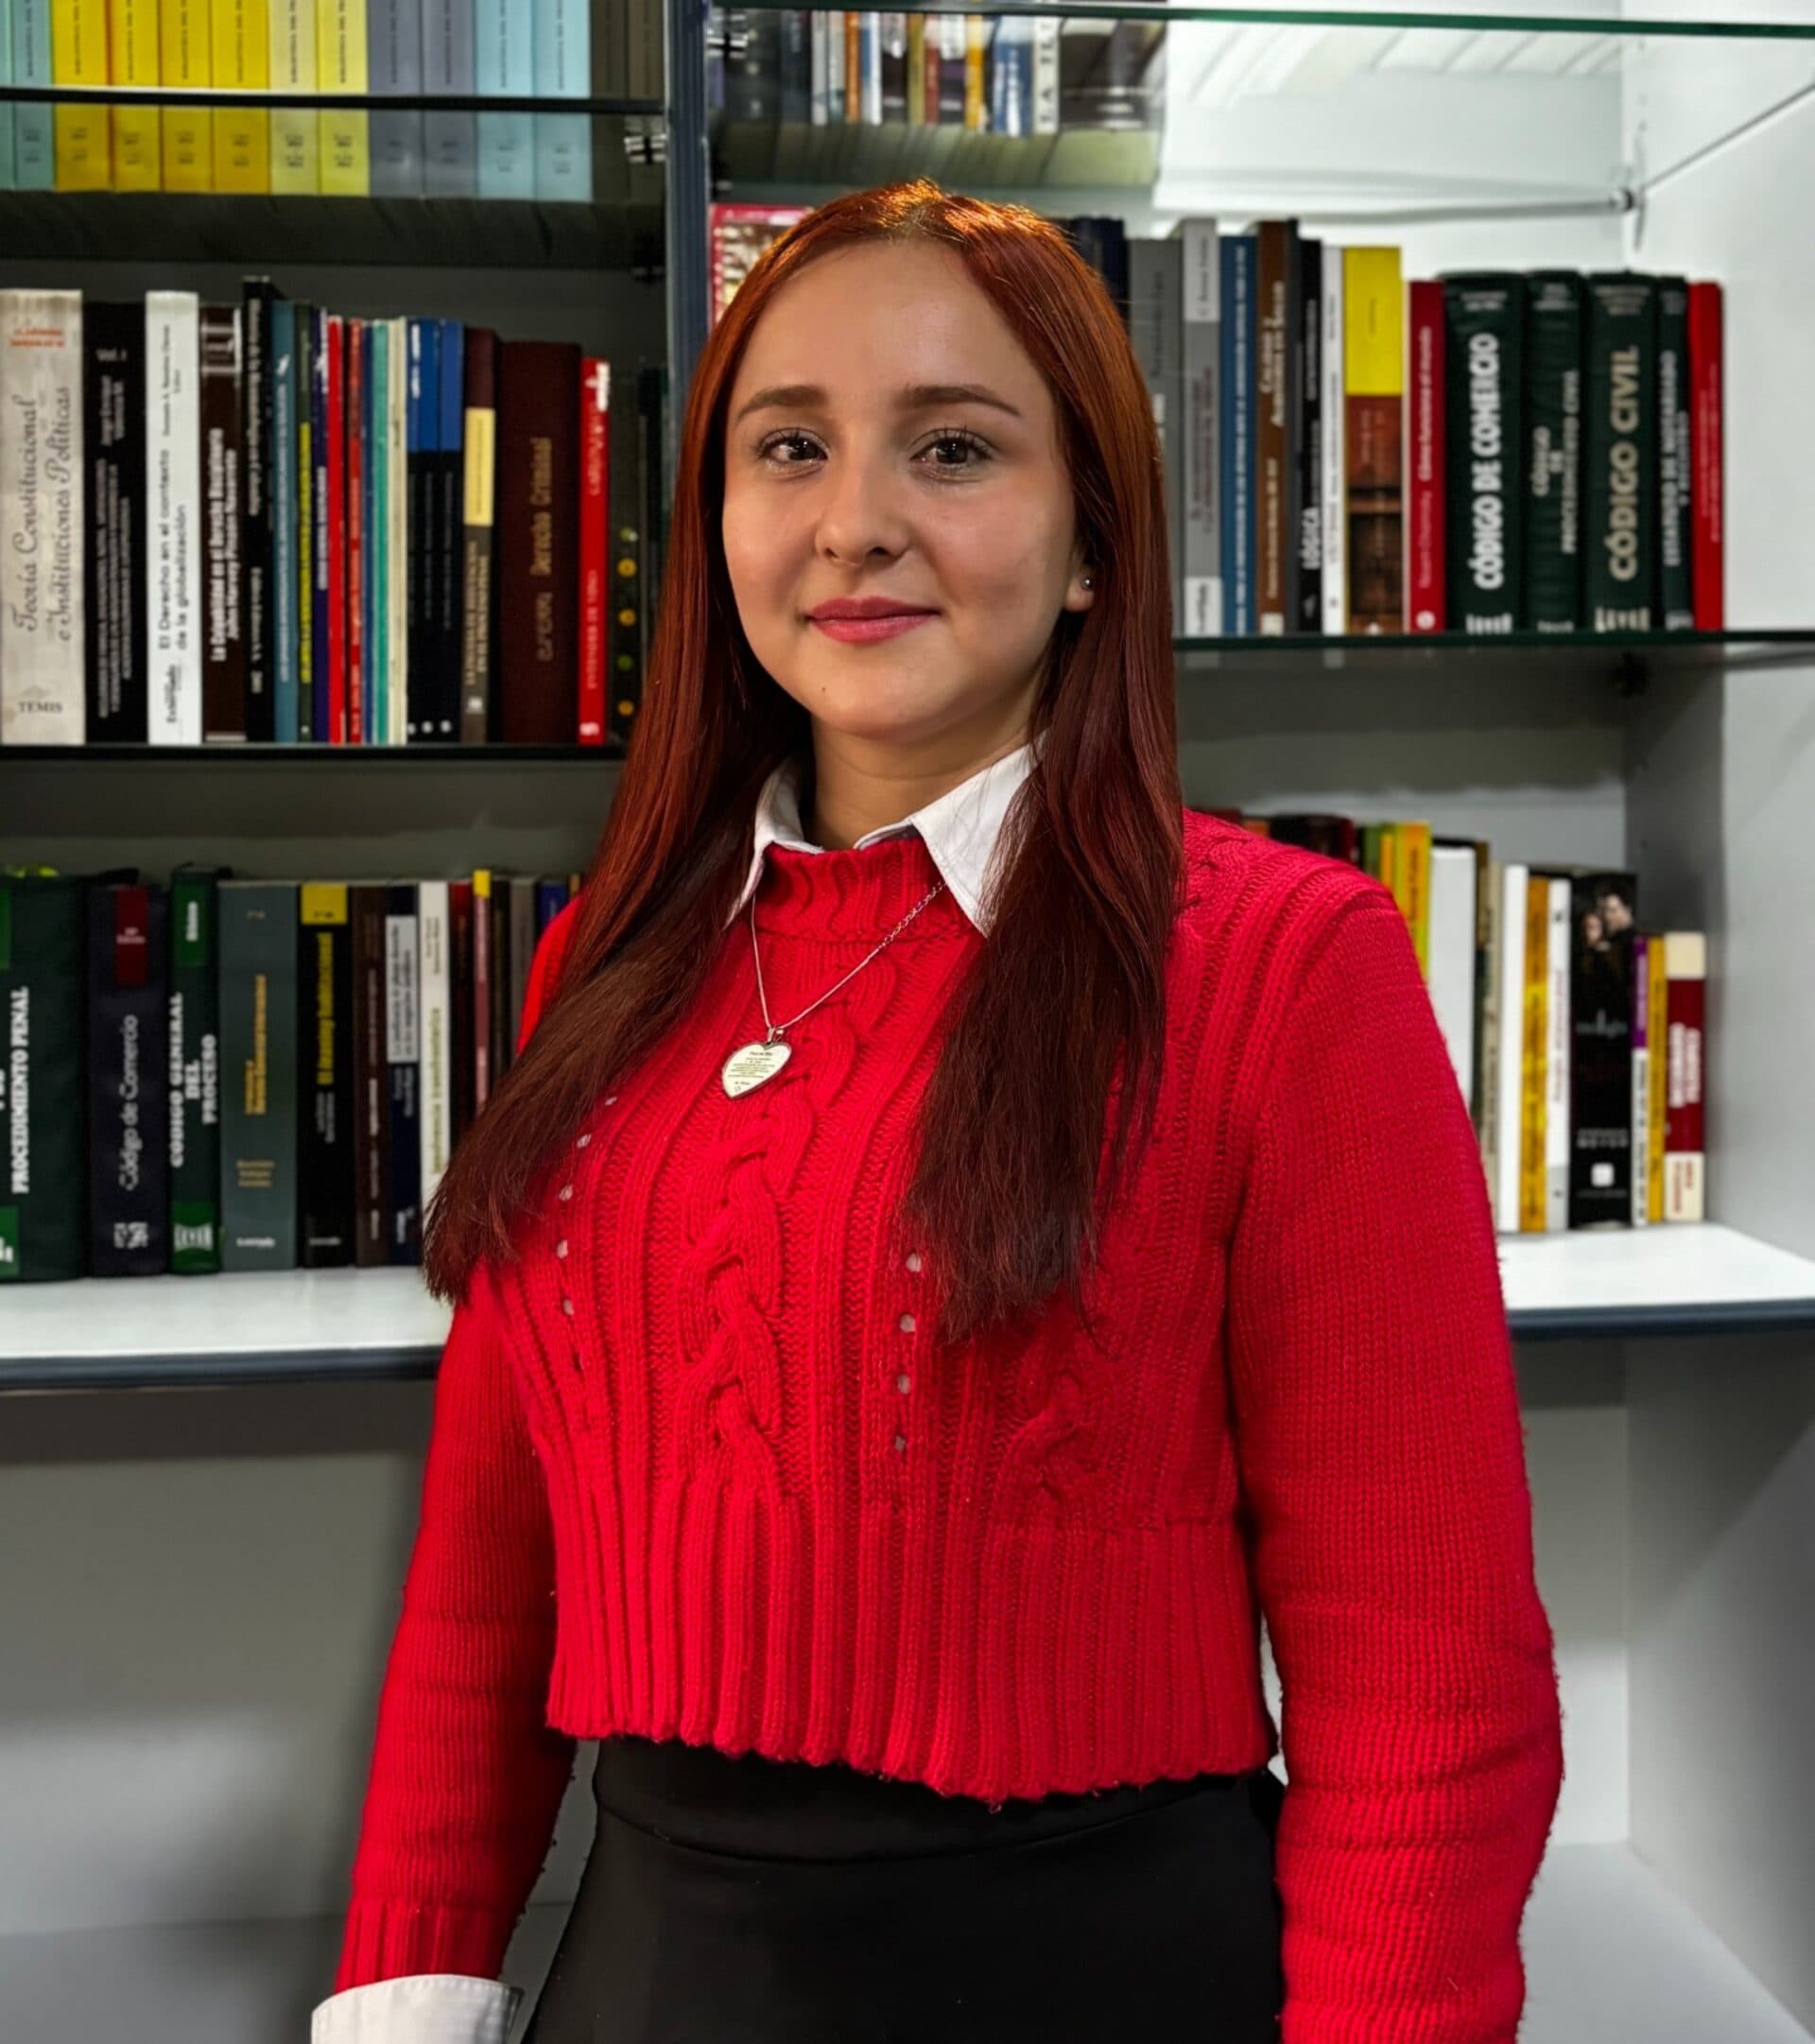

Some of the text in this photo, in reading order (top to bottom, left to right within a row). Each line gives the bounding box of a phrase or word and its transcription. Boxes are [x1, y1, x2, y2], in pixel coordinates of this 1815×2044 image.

[1469, 333, 1502, 459] COMERCIO
[1611, 346, 1639, 433] CIVIL
[207, 428, 224, 499] Disciplinario
[529, 437, 553, 506] Criminal
[1471, 459, 1502, 493] DE
[9, 397, 39, 632] Teoría Constitucional
[44, 386, 72, 642] e Instituciones Políticas
[158, 450, 171, 650] El Derecho en el contexto
[208, 500, 225, 547] Derecho
[529, 511, 553, 576] Derecho
[1299, 507, 1322, 570] LÓGICA
[1468, 494, 1504, 590] CÓDIGO
[1605, 442, 1638, 580] CÓDIGO
[174, 505, 190, 650] de la globalización
[209, 578, 227, 646] Culpabilidad
[210, 646, 227, 662] La
[19, 702, 62, 713] TEMIS
[170, 992, 184, 1086] GENERAL
[184, 1060, 199, 1100] DEL
[201, 1033, 216, 1124] PROCESO
[10, 986, 29, 1194] PROCEDIMIENTO PENAL
[118, 1014, 145, 1190] Código de Comercio
